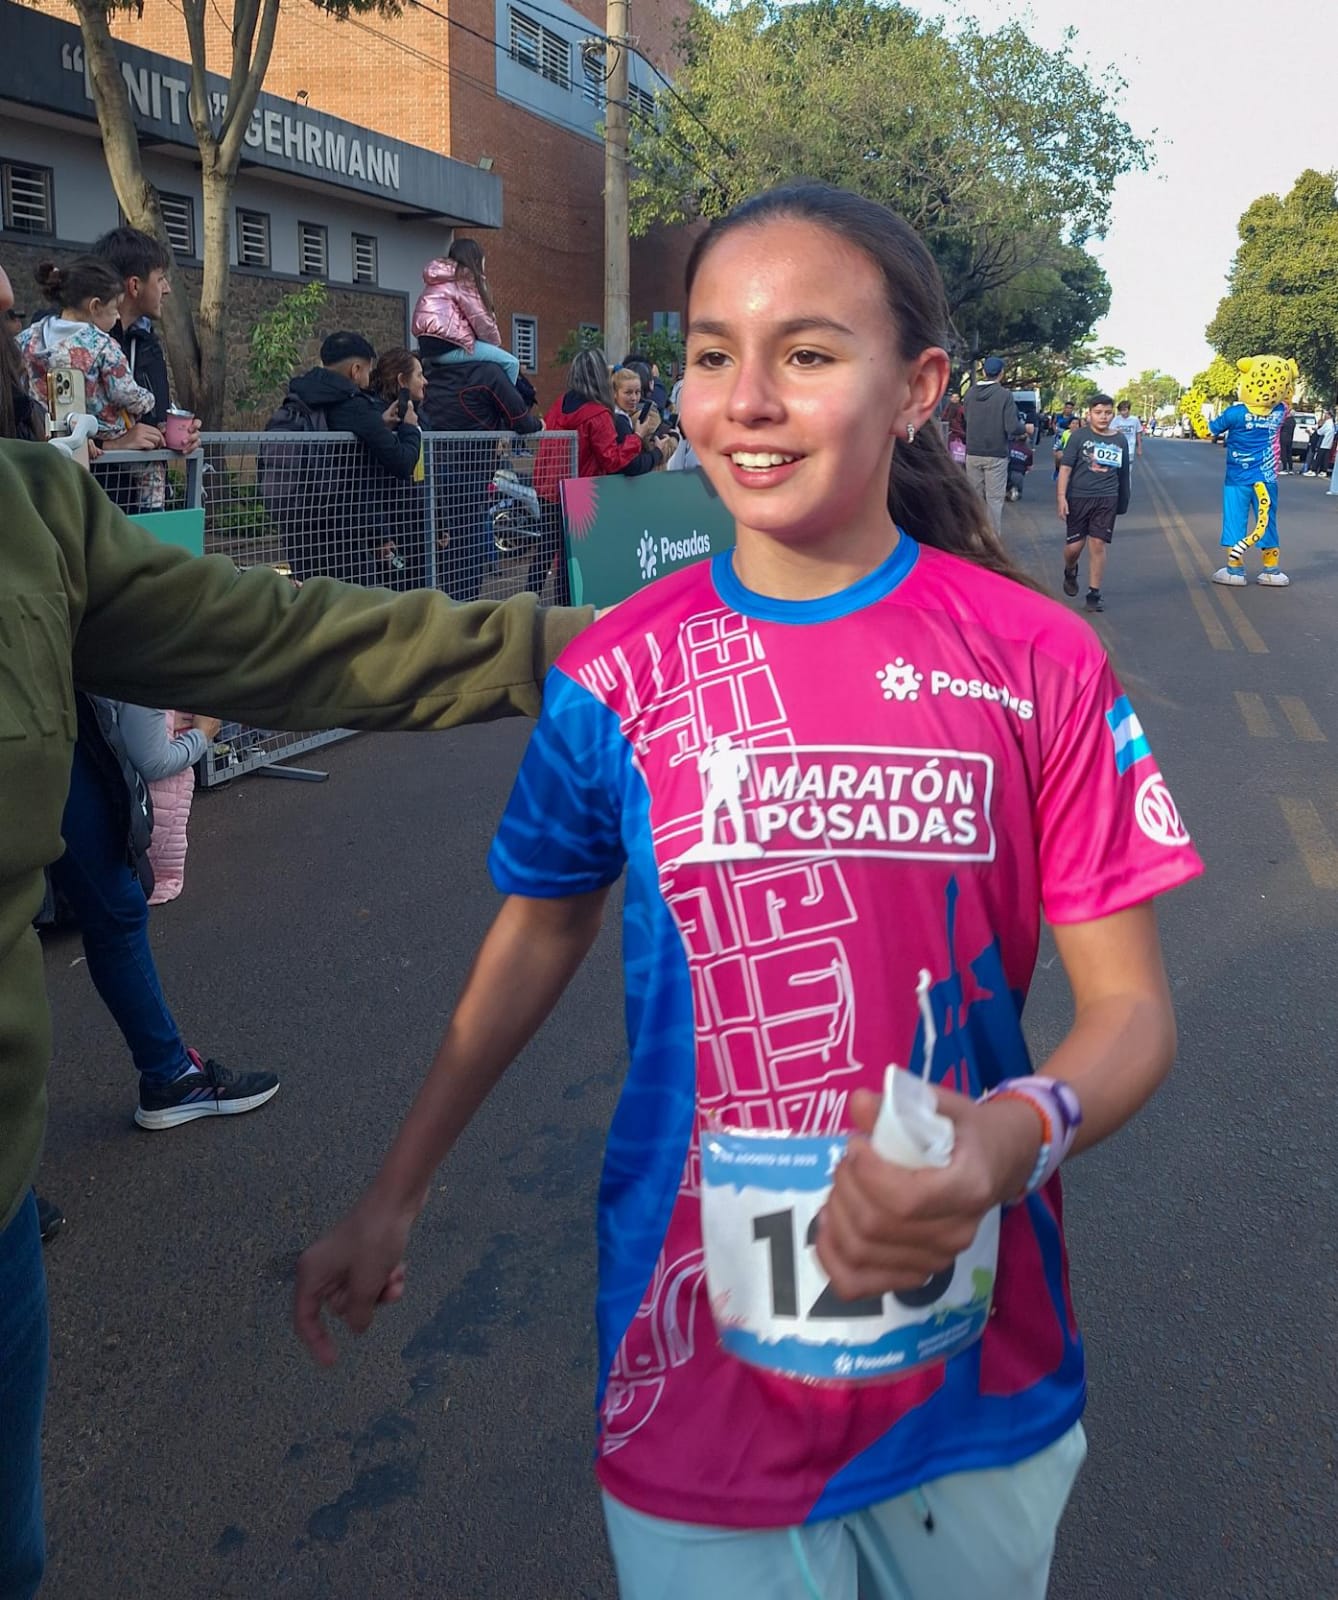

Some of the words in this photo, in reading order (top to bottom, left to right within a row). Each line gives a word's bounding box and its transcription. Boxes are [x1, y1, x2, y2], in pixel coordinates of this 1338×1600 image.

[245, 108, 400, 190] GEHRMANN
[1097, 449, 1119, 462] 022
[660, 530, 711, 563] Posadas
[760, 759, 974, 804] MARATÓN
[759, 804, 977, 844] POSADAS
